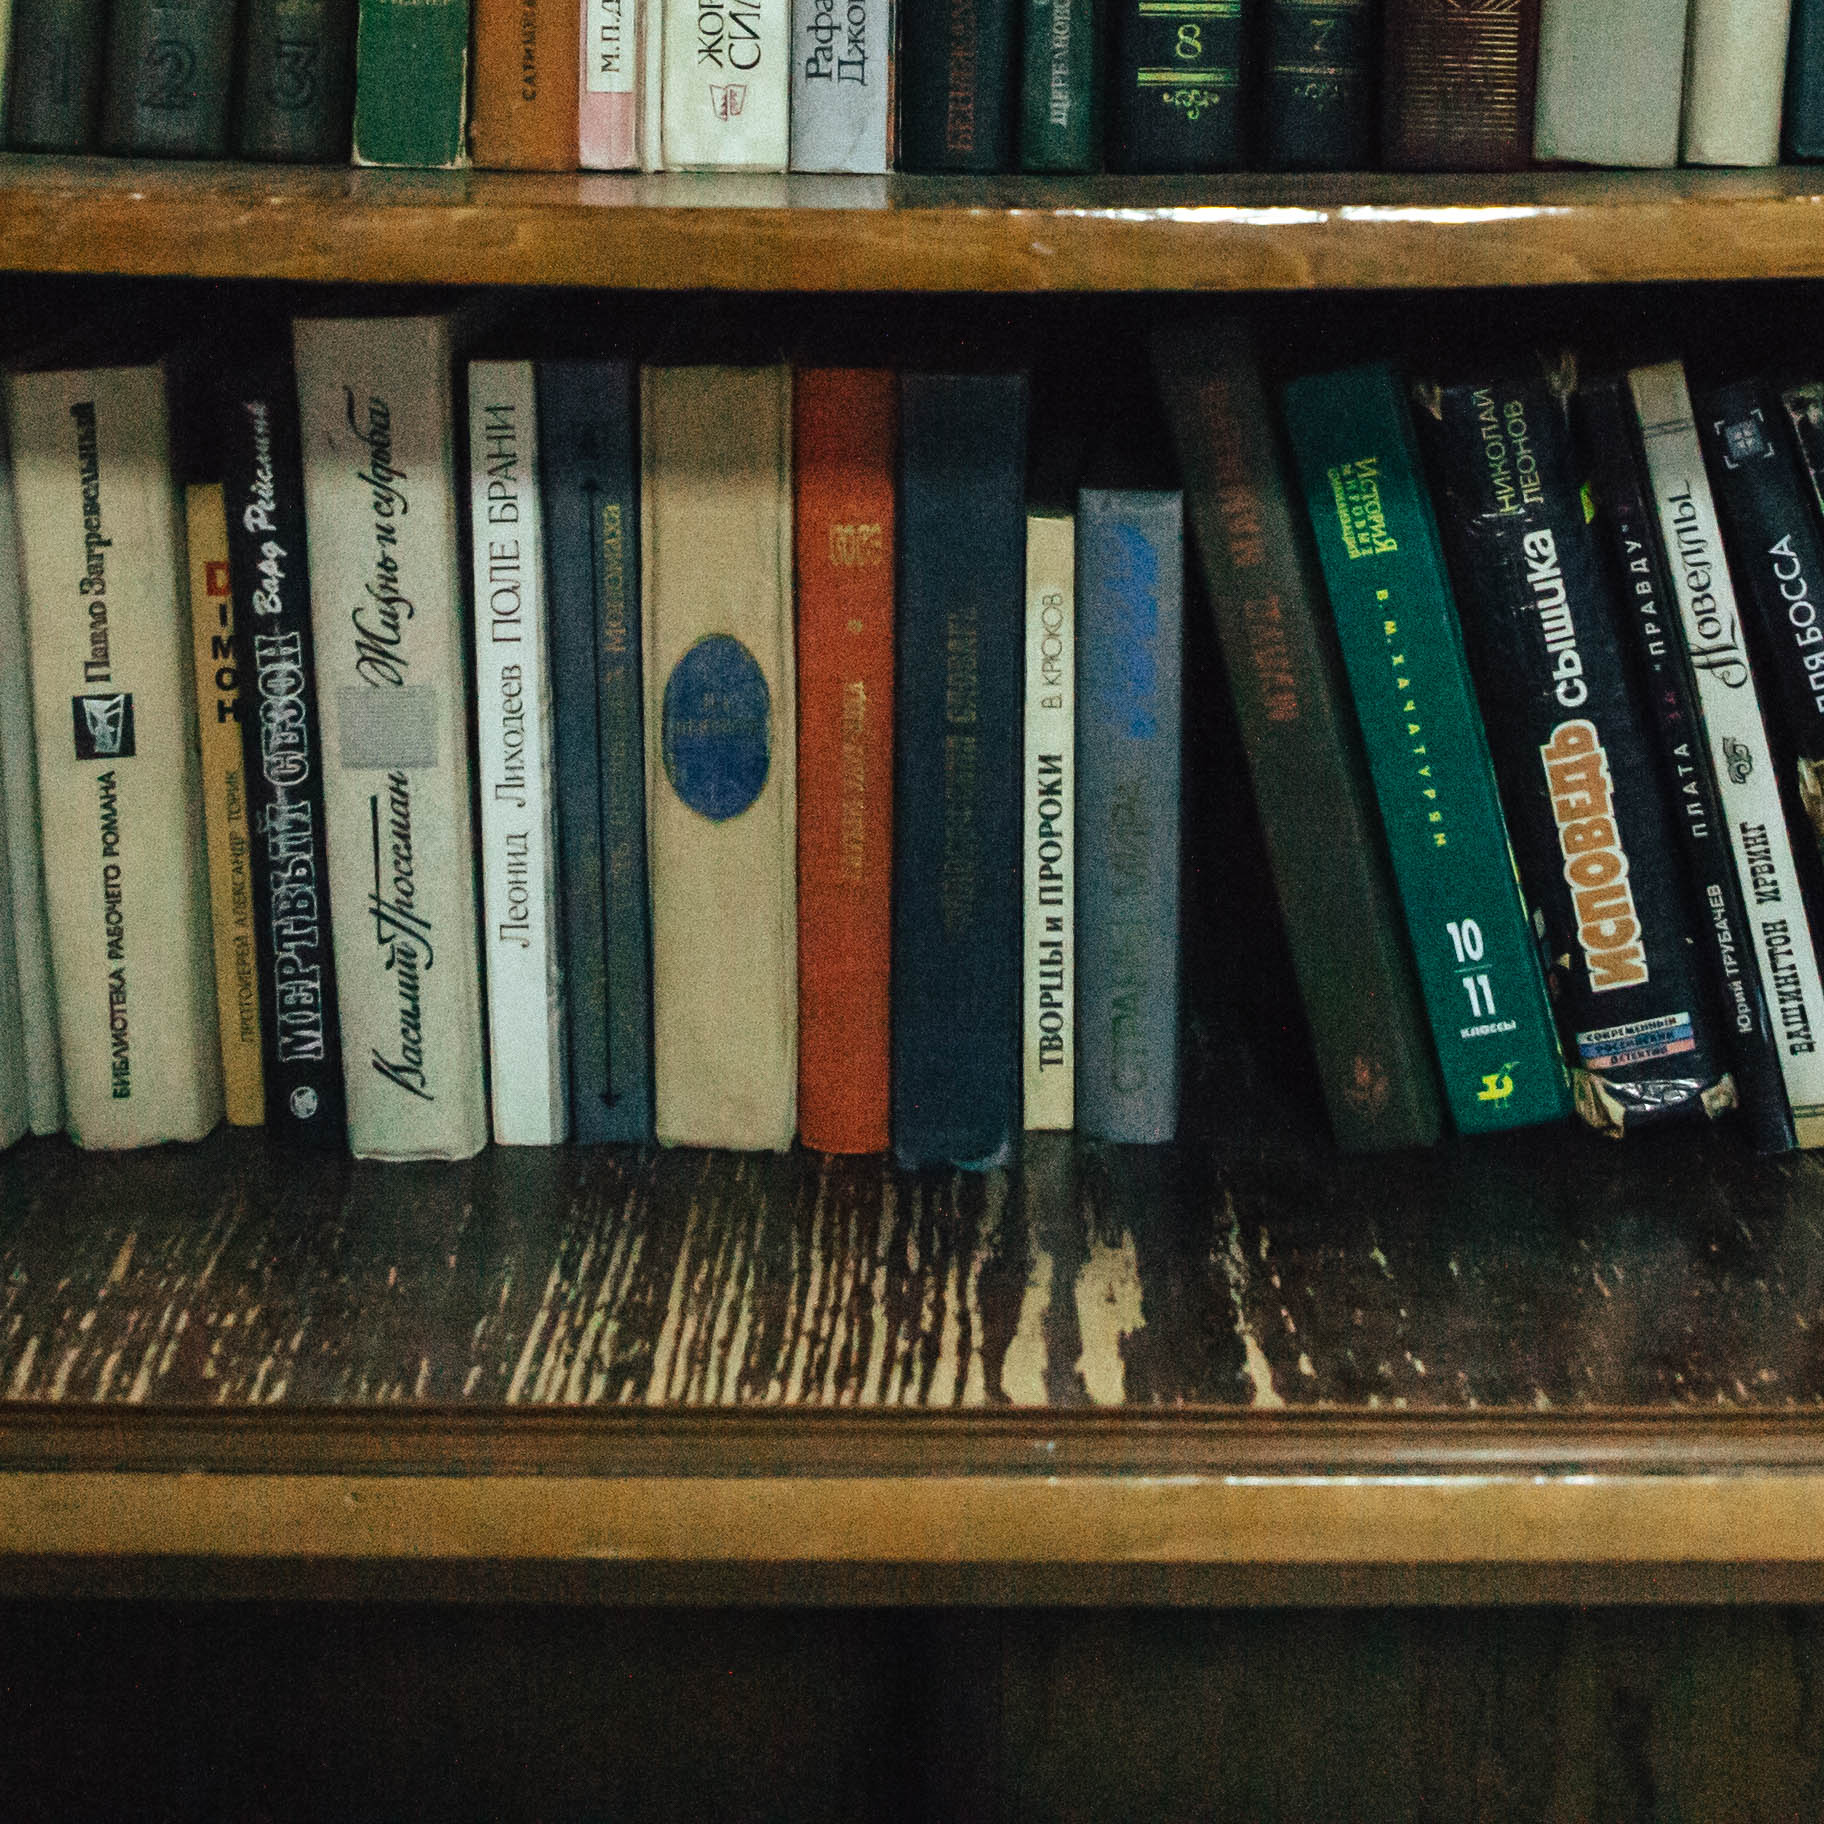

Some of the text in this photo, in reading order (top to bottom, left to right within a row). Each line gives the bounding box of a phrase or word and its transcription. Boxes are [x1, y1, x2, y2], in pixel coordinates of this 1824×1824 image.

[142, 37, 196, 110] 2
[265, 38, 320, 110] 3
[1175, 23, 1203, 60] 8
[1473, 387, 1518, 515] НИКОЛАЙ
[1503, 399, 1544, 505] ЛЕОНОВ
[253, 537, 288, 614] Вард
[343, 383, 414, 687] Жизнь и судьба
[1767, 533, 1824, 649] БОССА
[80, 600, 113, 683] Павло
[484, 402, 532, 947] Леонид Лиходеев ПОЛЕ БРАНИ
[1040, 592, 1063, 708] В. КРЮКОВ
[254, 629, 308, 785] СЕЗОН
[1673, 742, 1709, 840] ПЛАТА
[224, 768, 256, 1041] ПРОТОИЕРЕЙ АЛЕКСАНДР ТОРИК
[1037, 752, 1068, 1070] ТВОРЦЫ и ПРОРОКИ
[1540, 718, 1650, 994] ИСПОВЕДЬ
[95, 770, 132, 1098] БИБЛИОТЕКА РАБОЧЕГО РОМАНА
[258, 799, 326, 1061] МЕРТВЫЙ
[370, 769, 435, 1099] Василий Гроссман
[1445, 917, 1485, 963] 10
[1706, 883, 1753, 1035] Юрий ТРУБАЧЕВ
[1739, 821, 1817, 1056] ВАШИНГТОН ИРВИНГ
[1462, 974, 1497, 1018] 11
